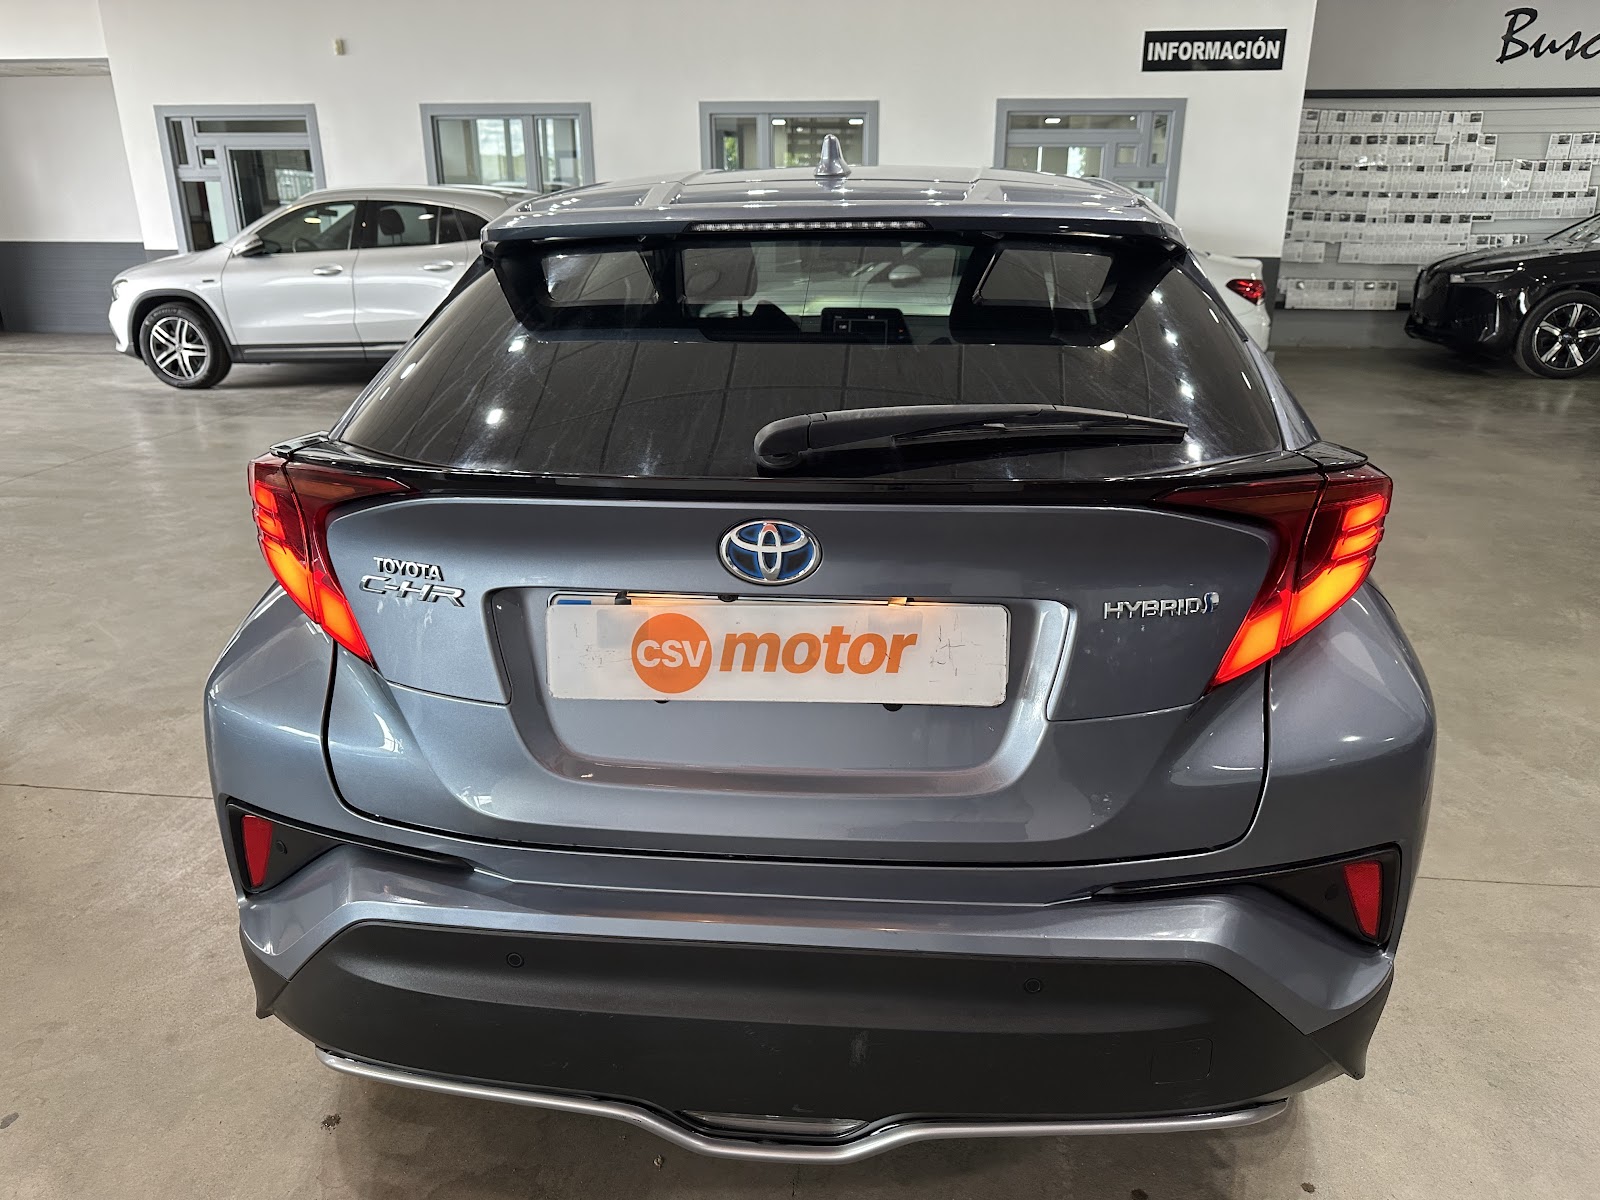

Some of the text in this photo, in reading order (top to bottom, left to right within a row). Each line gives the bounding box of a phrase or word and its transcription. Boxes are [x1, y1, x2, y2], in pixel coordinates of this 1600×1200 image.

[1147, 36, 1280, 61] INFORMACIÓN
[373, 556, 444, 581] TOYOTA
[359, 574, 465, 607] C-HR
[1104, 598, 1202, 619] HYBRID
[636, 625, 918, 674] CSV motor
